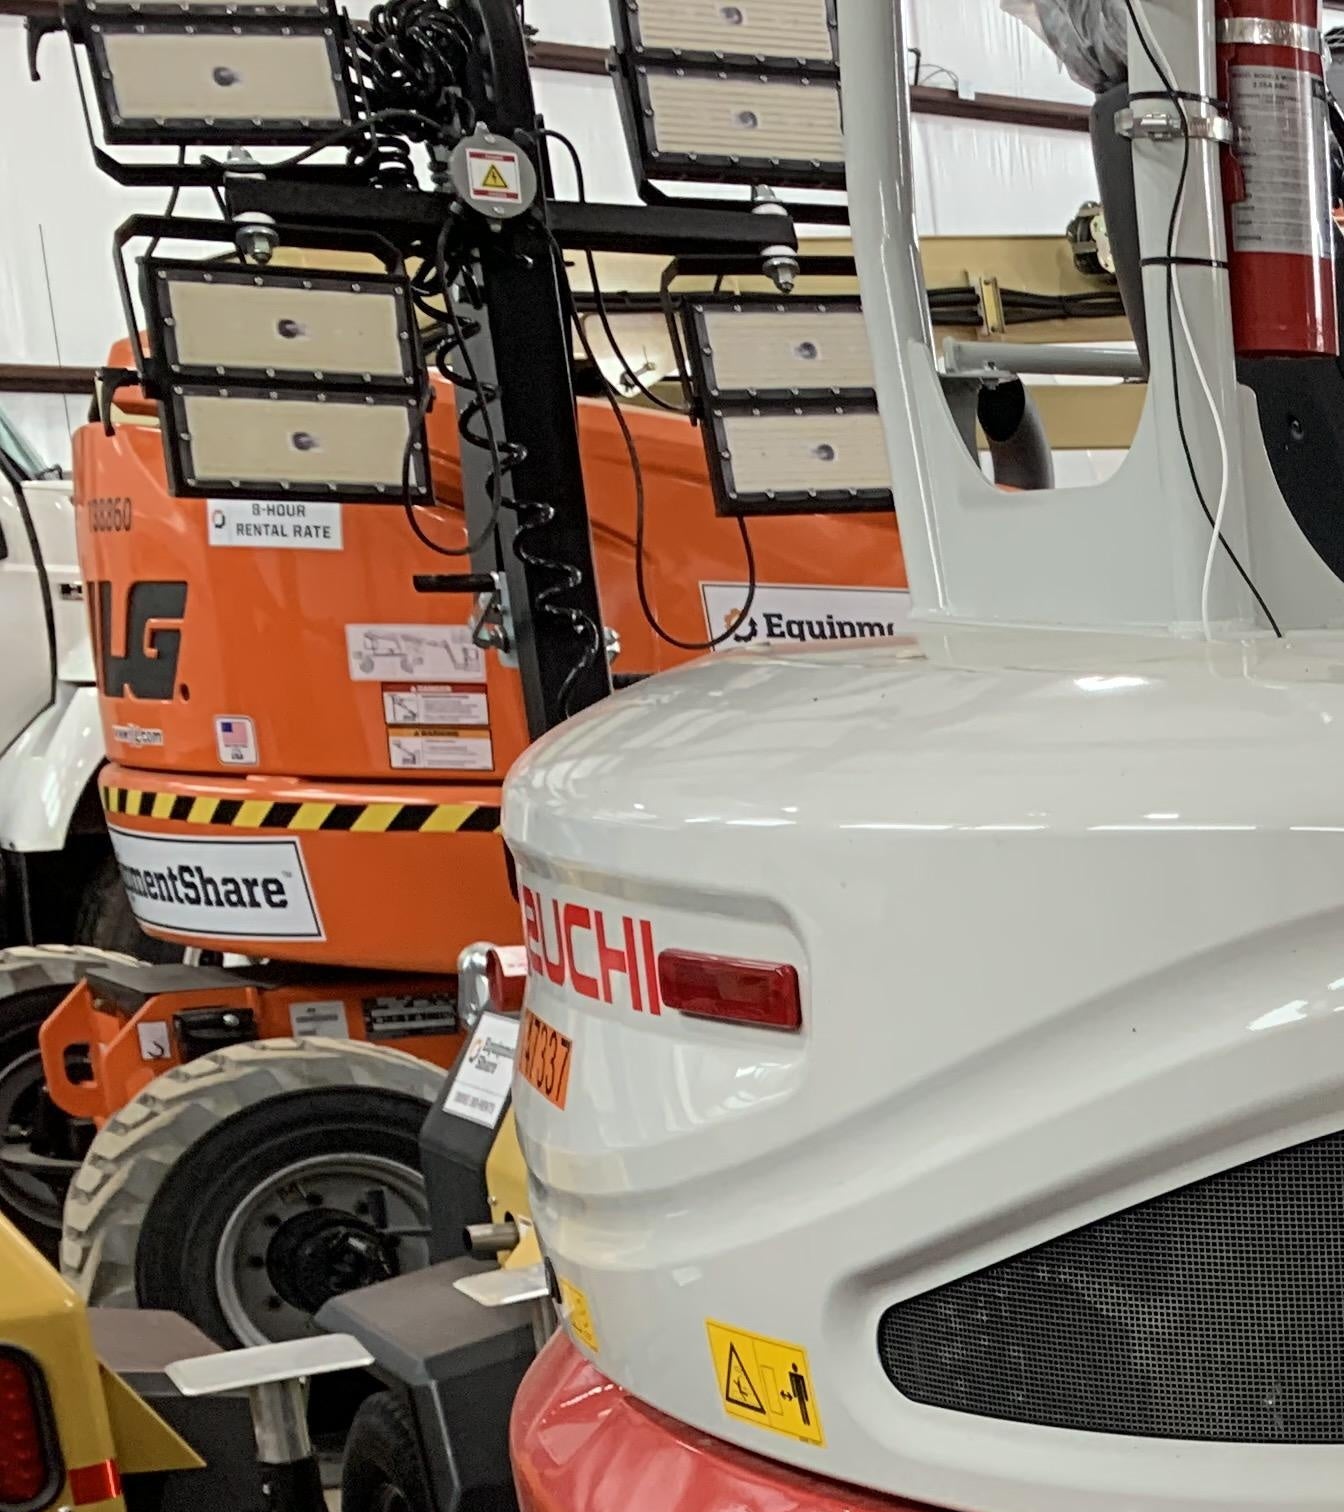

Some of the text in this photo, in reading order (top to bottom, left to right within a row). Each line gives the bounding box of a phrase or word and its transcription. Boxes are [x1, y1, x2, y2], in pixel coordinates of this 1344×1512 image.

[252, 503, 306, 518] 8-HOUR
[236, 523, 332, 539] RENTAL RATE
